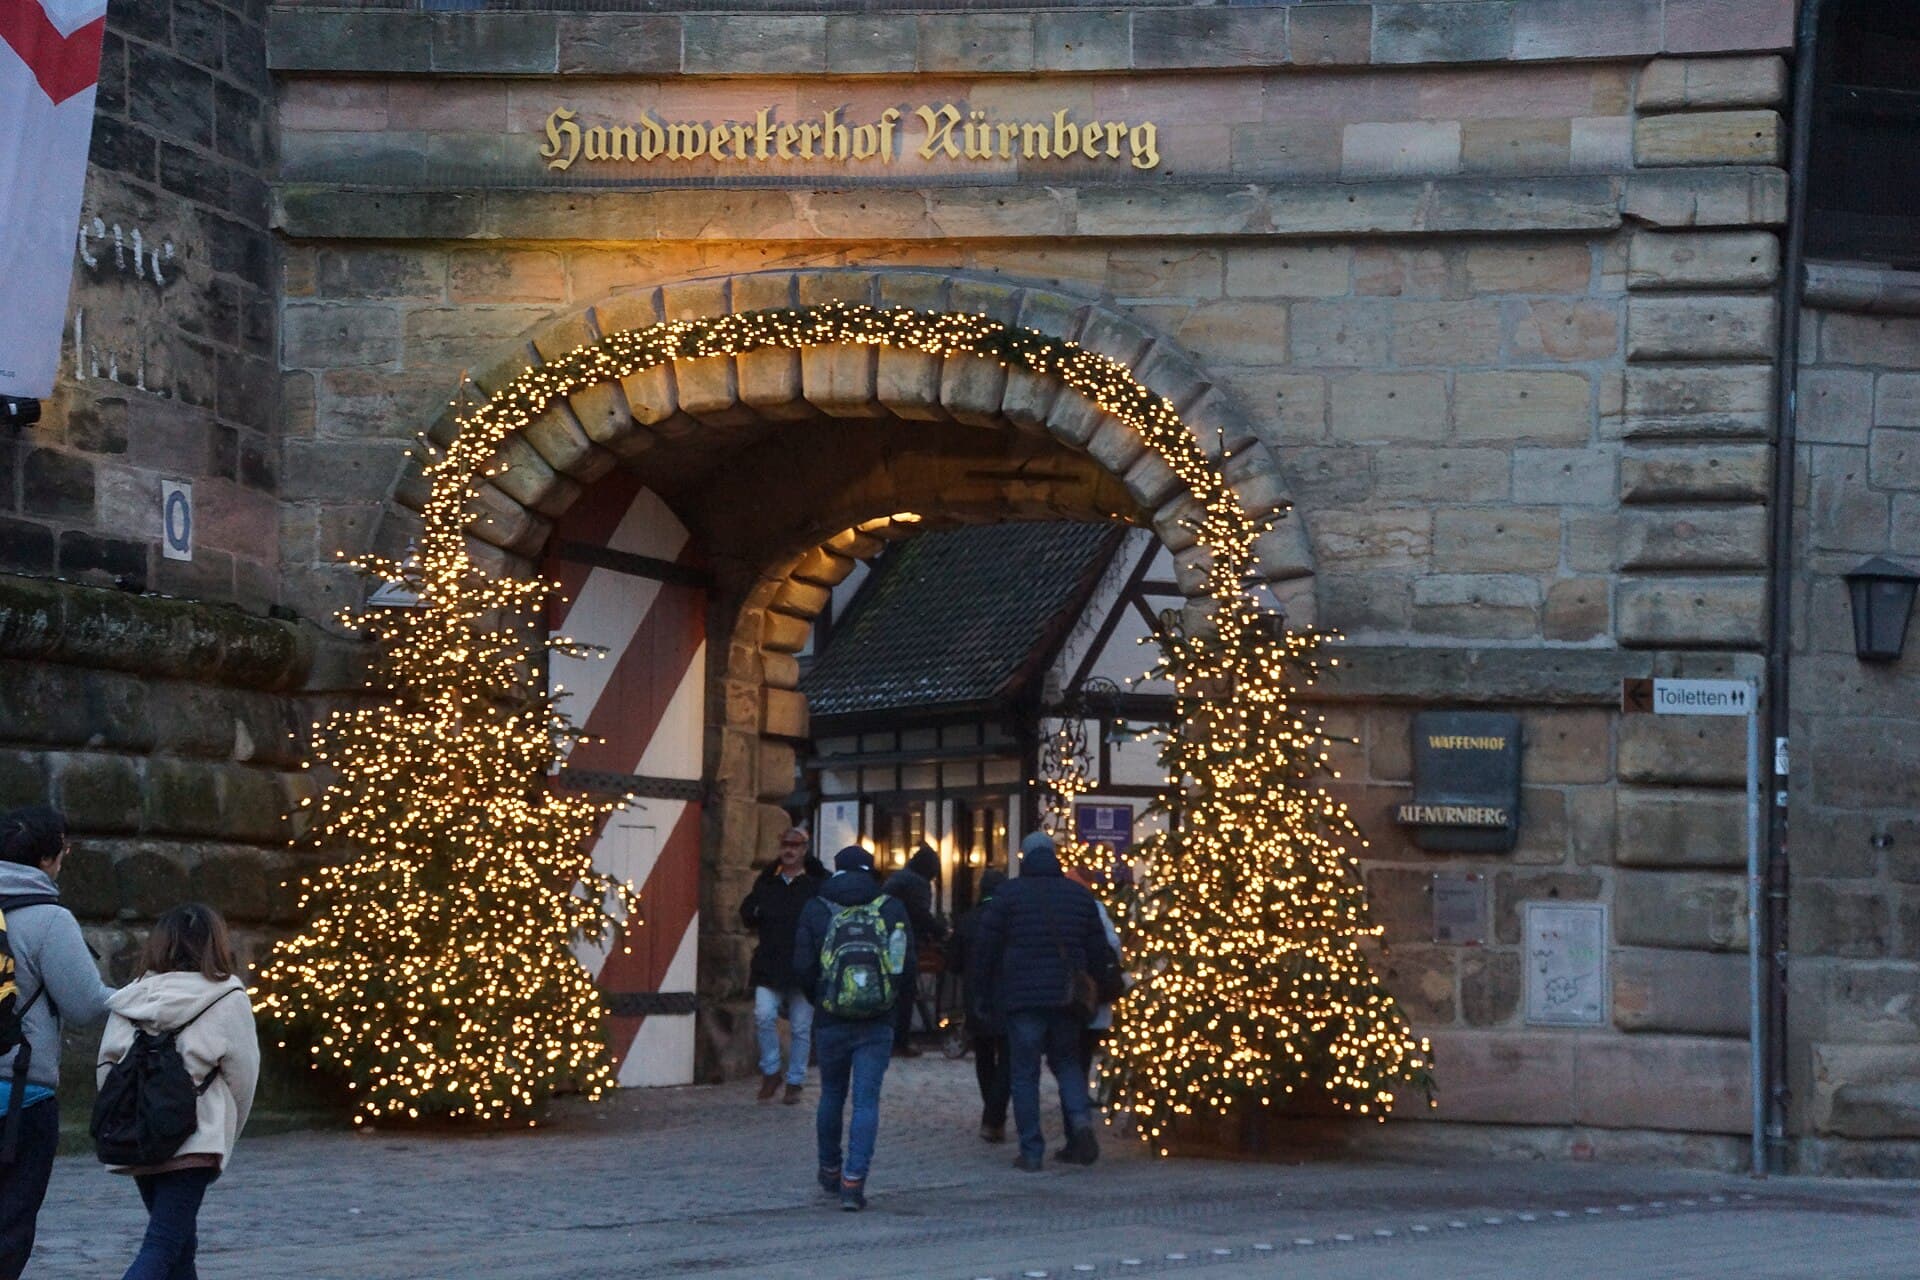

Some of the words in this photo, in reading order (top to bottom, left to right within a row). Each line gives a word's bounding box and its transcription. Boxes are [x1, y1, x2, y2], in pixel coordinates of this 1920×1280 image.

[540, 105, 900, 171] Handwerkerhof
[914, 103, 1160, 169] Nürnberg
[1657, 687, 1729, 706] Toiletten
[1428, 735, 1506, 751] WAFFENHOF
